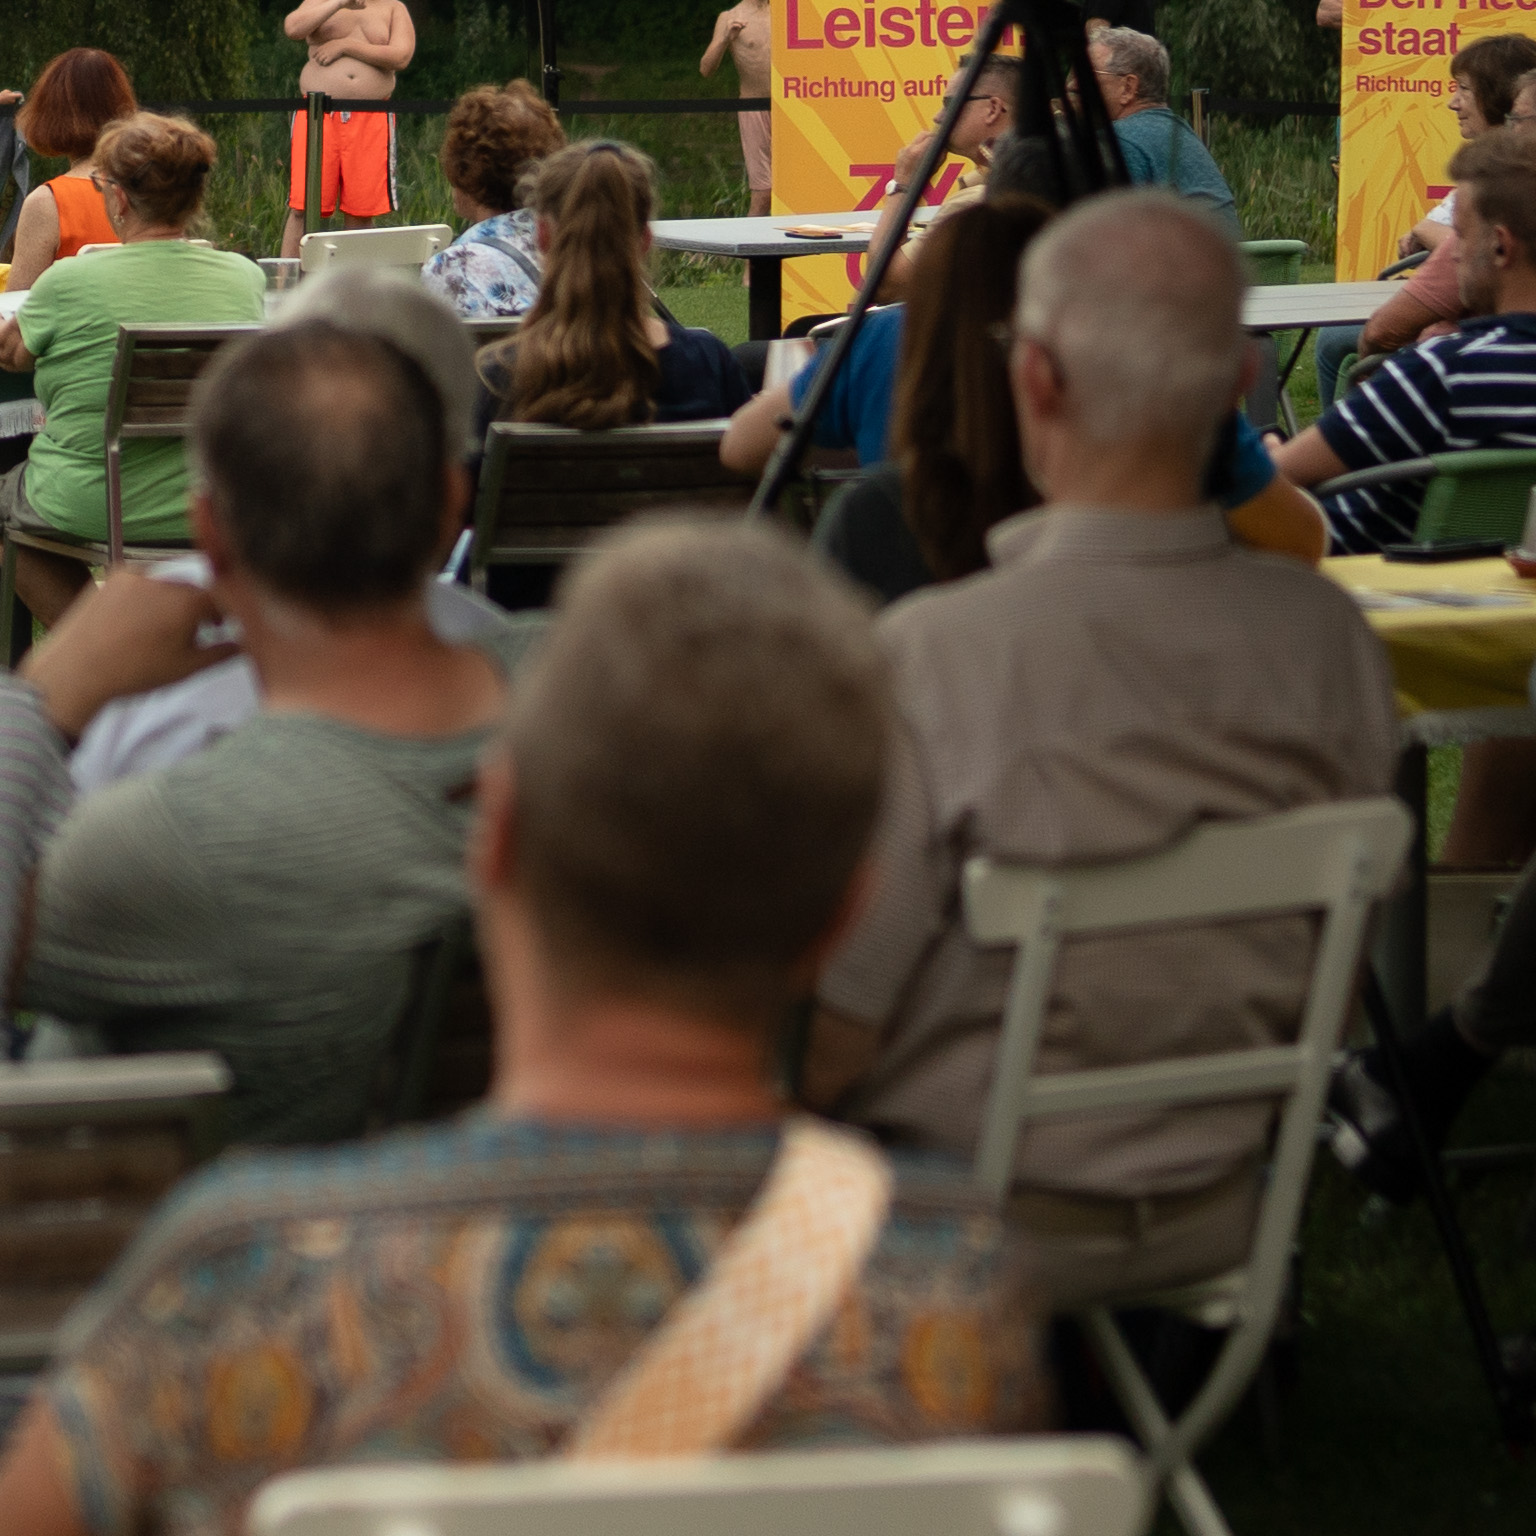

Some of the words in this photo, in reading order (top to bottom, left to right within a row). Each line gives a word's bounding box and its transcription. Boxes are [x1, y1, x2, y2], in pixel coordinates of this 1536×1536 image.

[783, 75, 896, 103] Richtung
[903, 74, 948, 97] auf
[1356, 75, 1442, 97] Richtung
